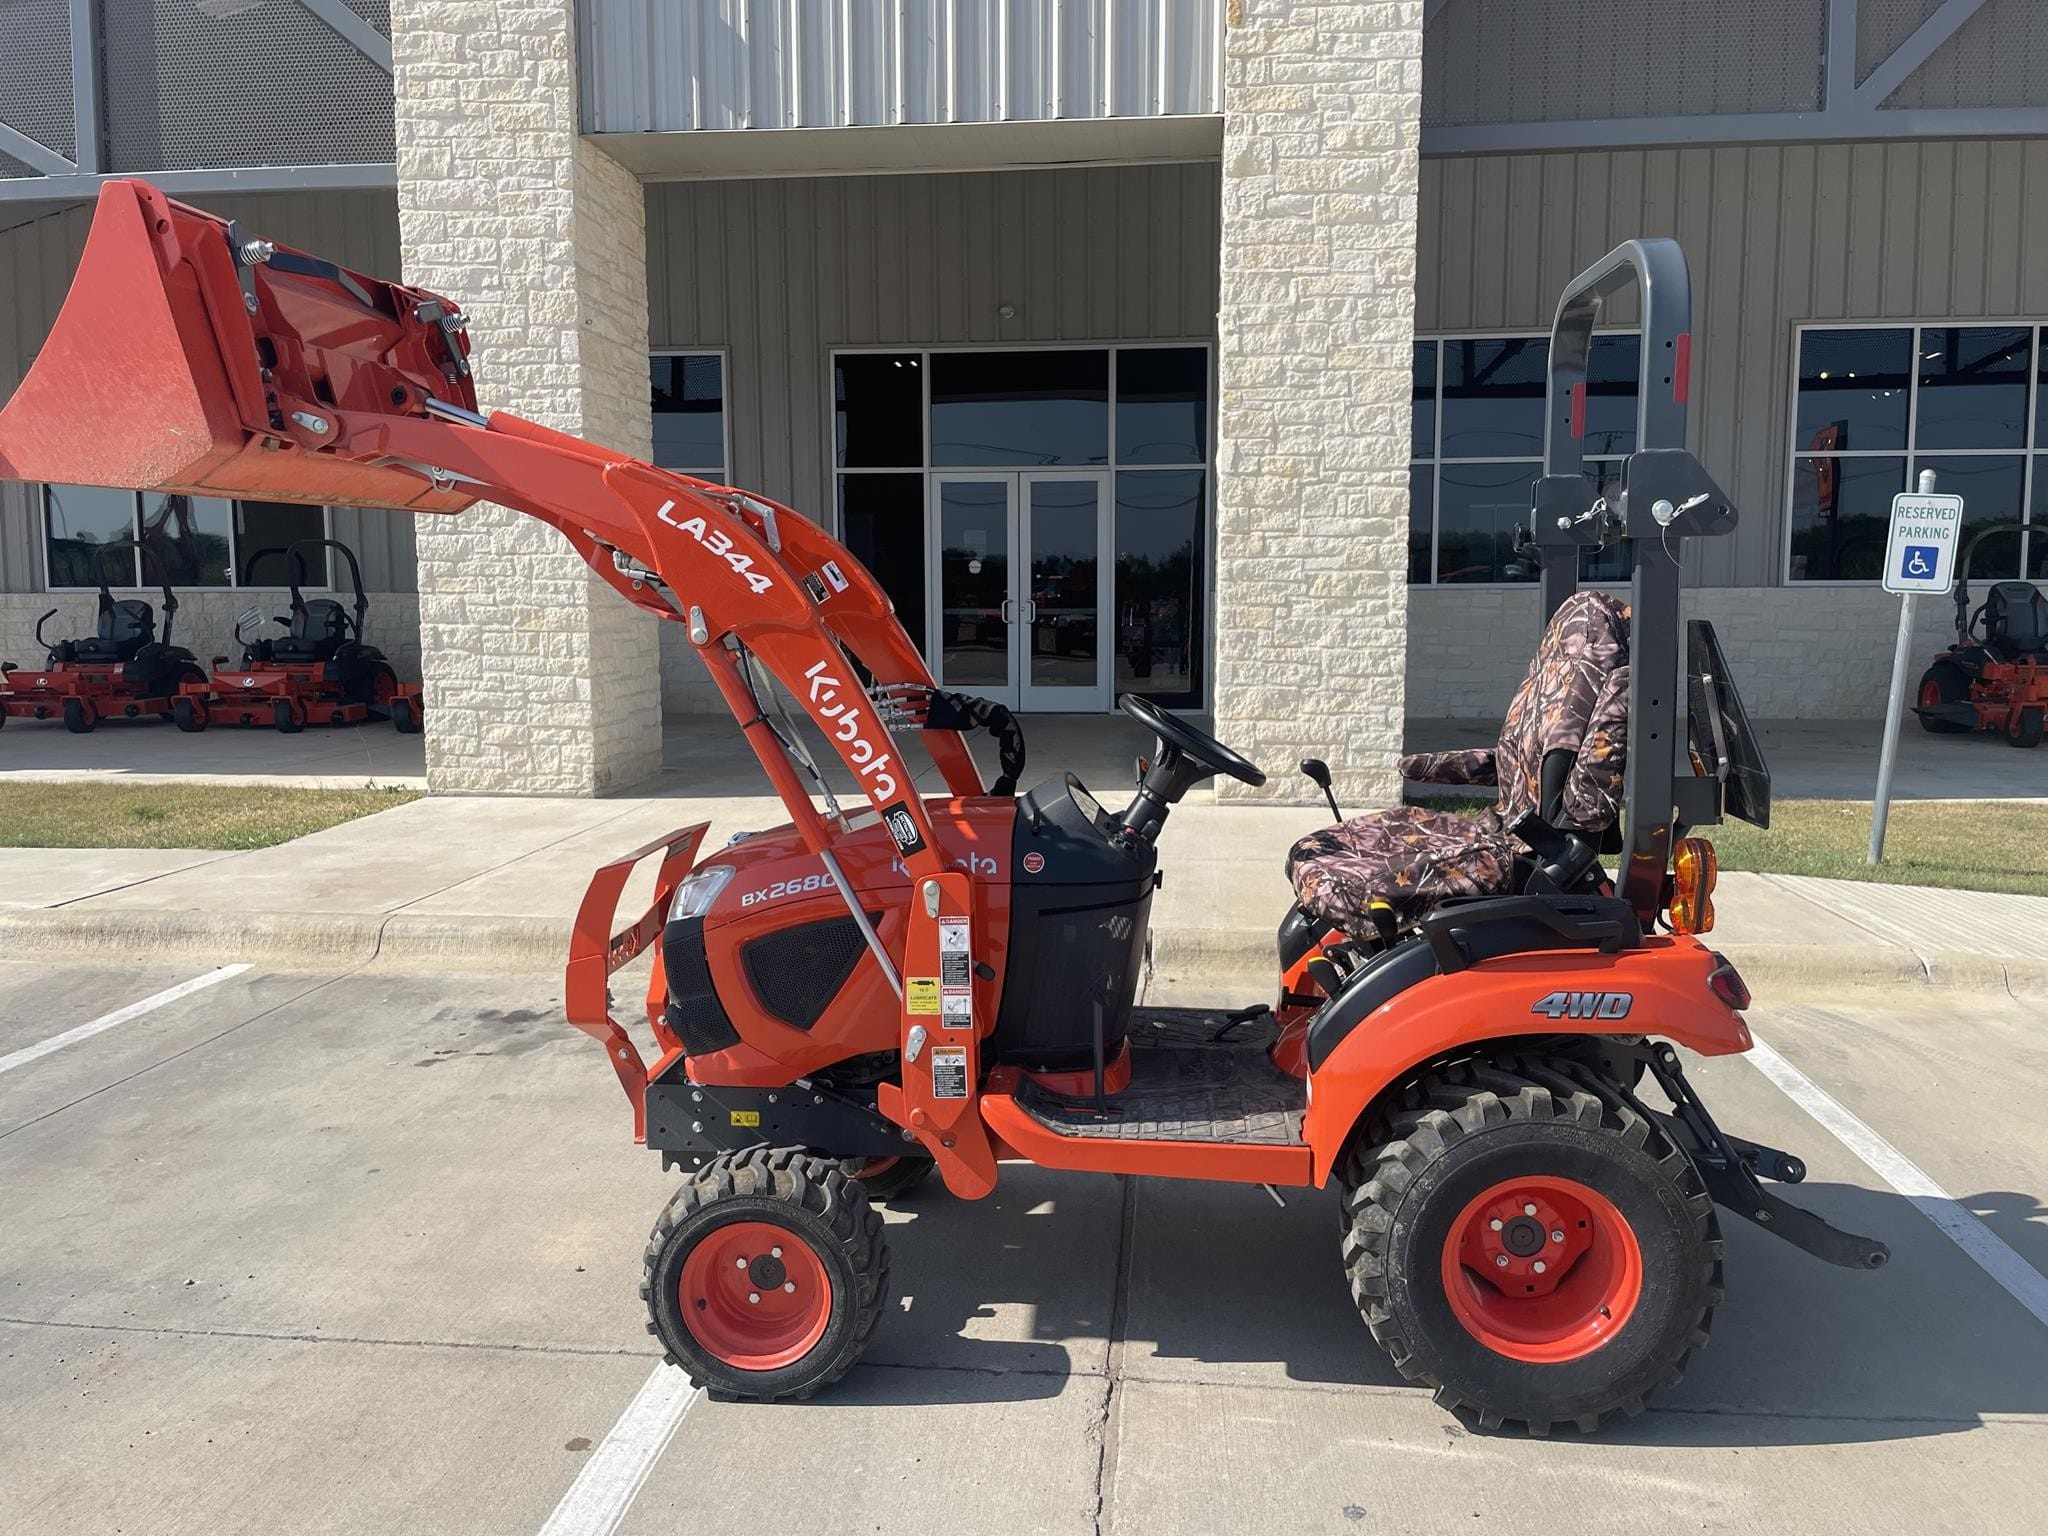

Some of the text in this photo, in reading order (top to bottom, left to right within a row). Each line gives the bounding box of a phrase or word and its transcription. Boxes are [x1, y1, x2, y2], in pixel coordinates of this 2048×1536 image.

[1897, 506, 1956, 520] RESERVED
[1898, 526, 1950, 539] PARKING
[656, 500, 774, 594] LA344
[804, 660, 896, 802] Kubota
[892, 851, 997, 877] Kota
[741, 873, 836, 907] BX2680
[1531, 991, 1633, 1019] 4WD
